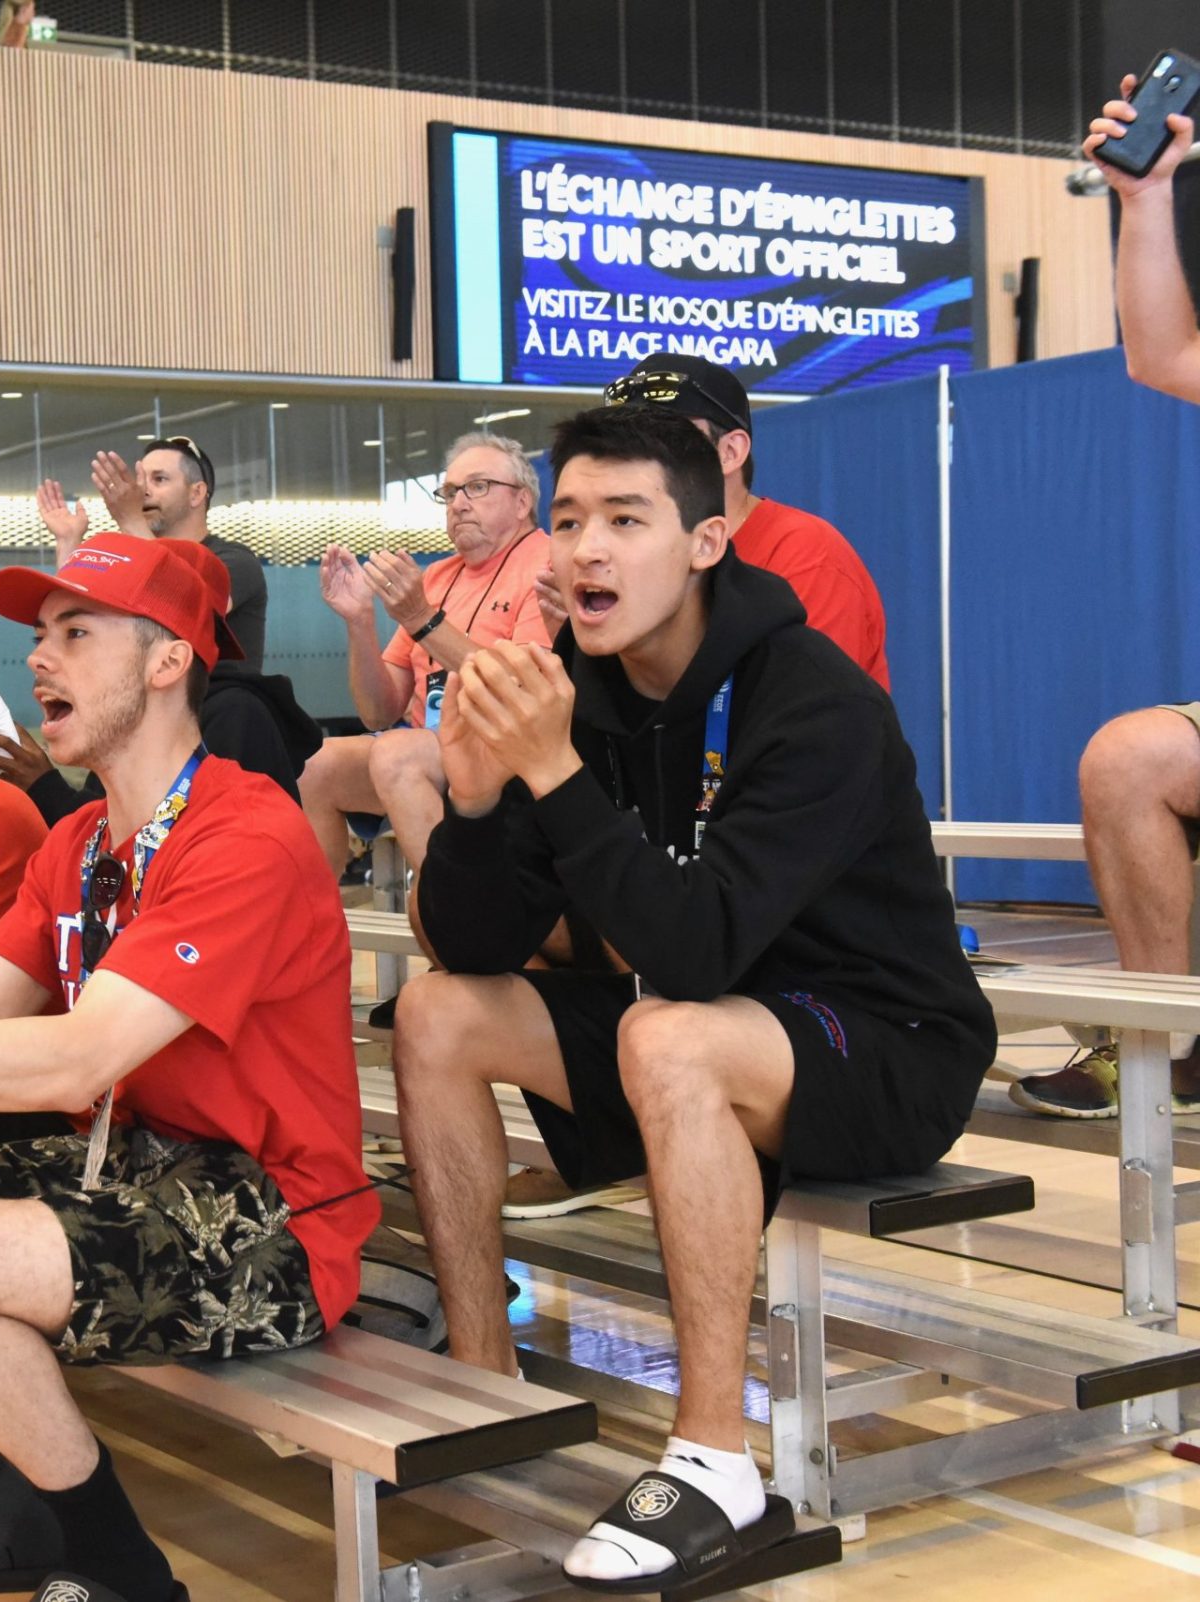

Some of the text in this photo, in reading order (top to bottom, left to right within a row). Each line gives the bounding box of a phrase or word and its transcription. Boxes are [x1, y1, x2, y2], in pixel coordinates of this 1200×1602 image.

[521, 163, 957, 244] L'ÉCHANGE D'ÉPINGLETTES
[522, 218, 906, 284] EST UN SPORT OFFICIEL
[522, 287, 920, 338] VISITEZ LE KIOSQUE D'ÉPINGLETTES
[523, 319, 546, 355] À
[550, 327, 584, 357] LA
[667, 333, 777, 367] NIAGARA
